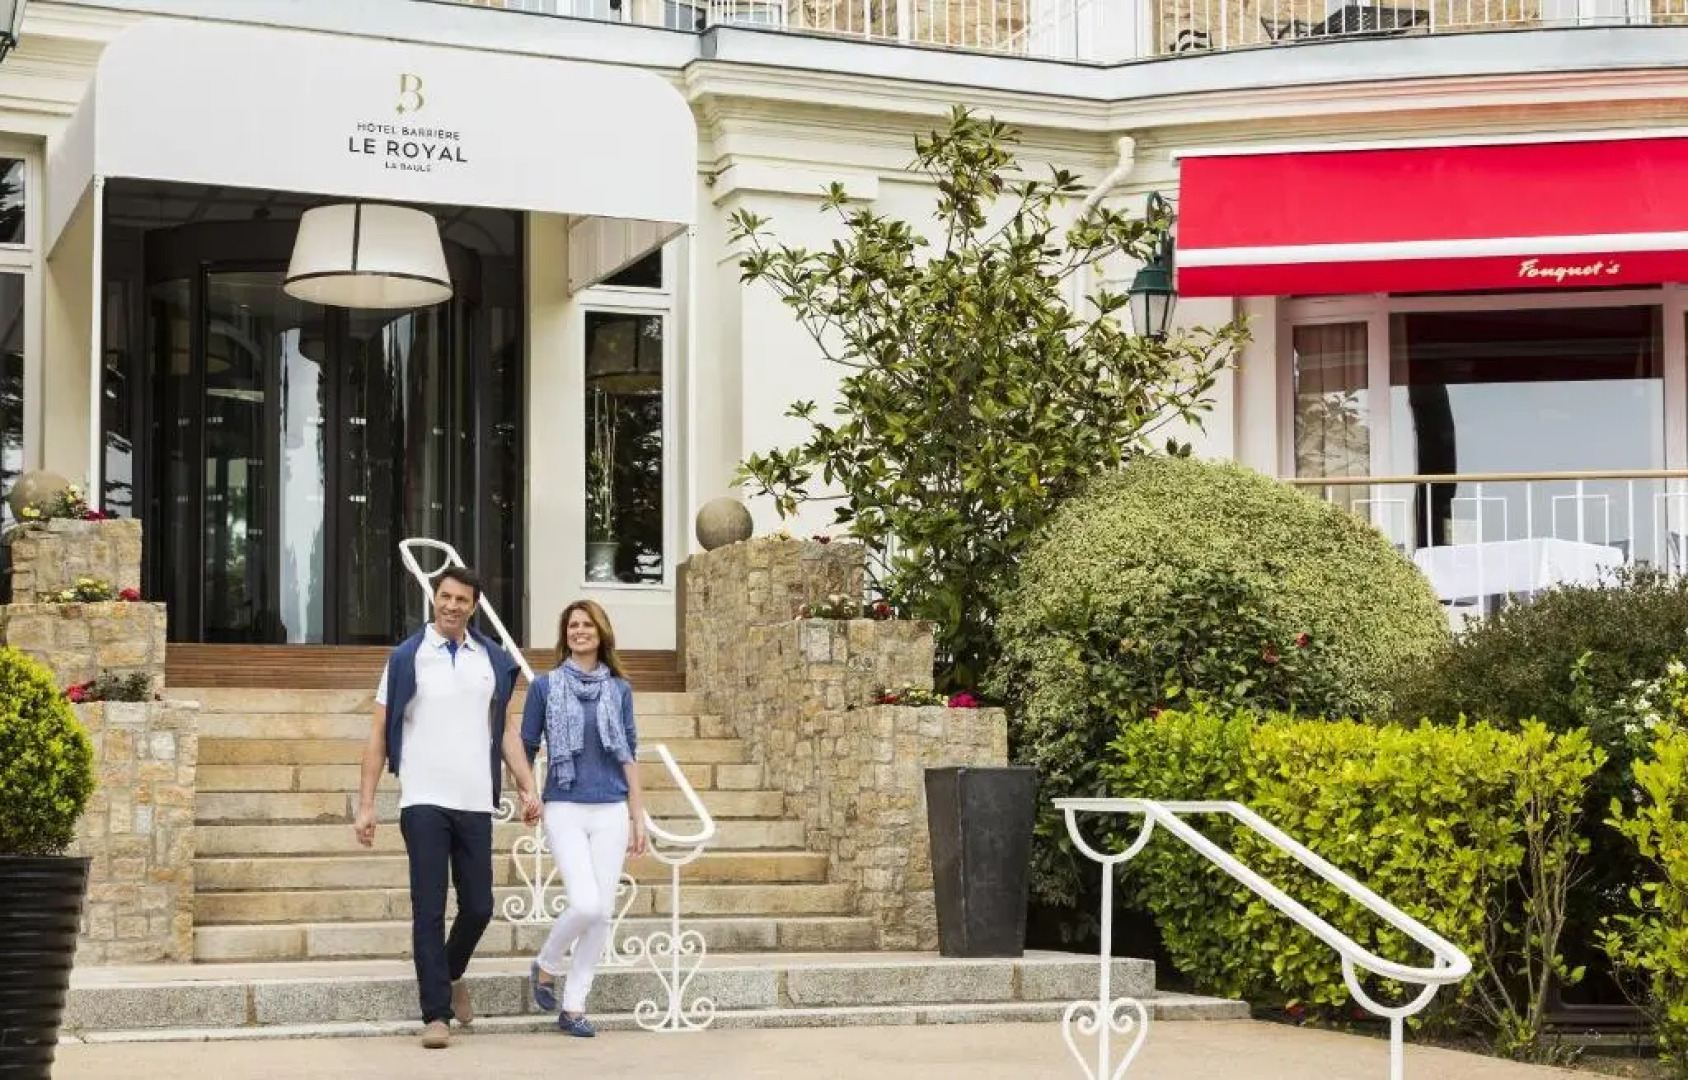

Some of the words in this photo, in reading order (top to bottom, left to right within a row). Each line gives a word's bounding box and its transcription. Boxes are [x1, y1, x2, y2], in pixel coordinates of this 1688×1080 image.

[349, 136, 376, 154] LE
[386, 139, 468, 163] ROYAL
[385, 161, 397, 169] LA
